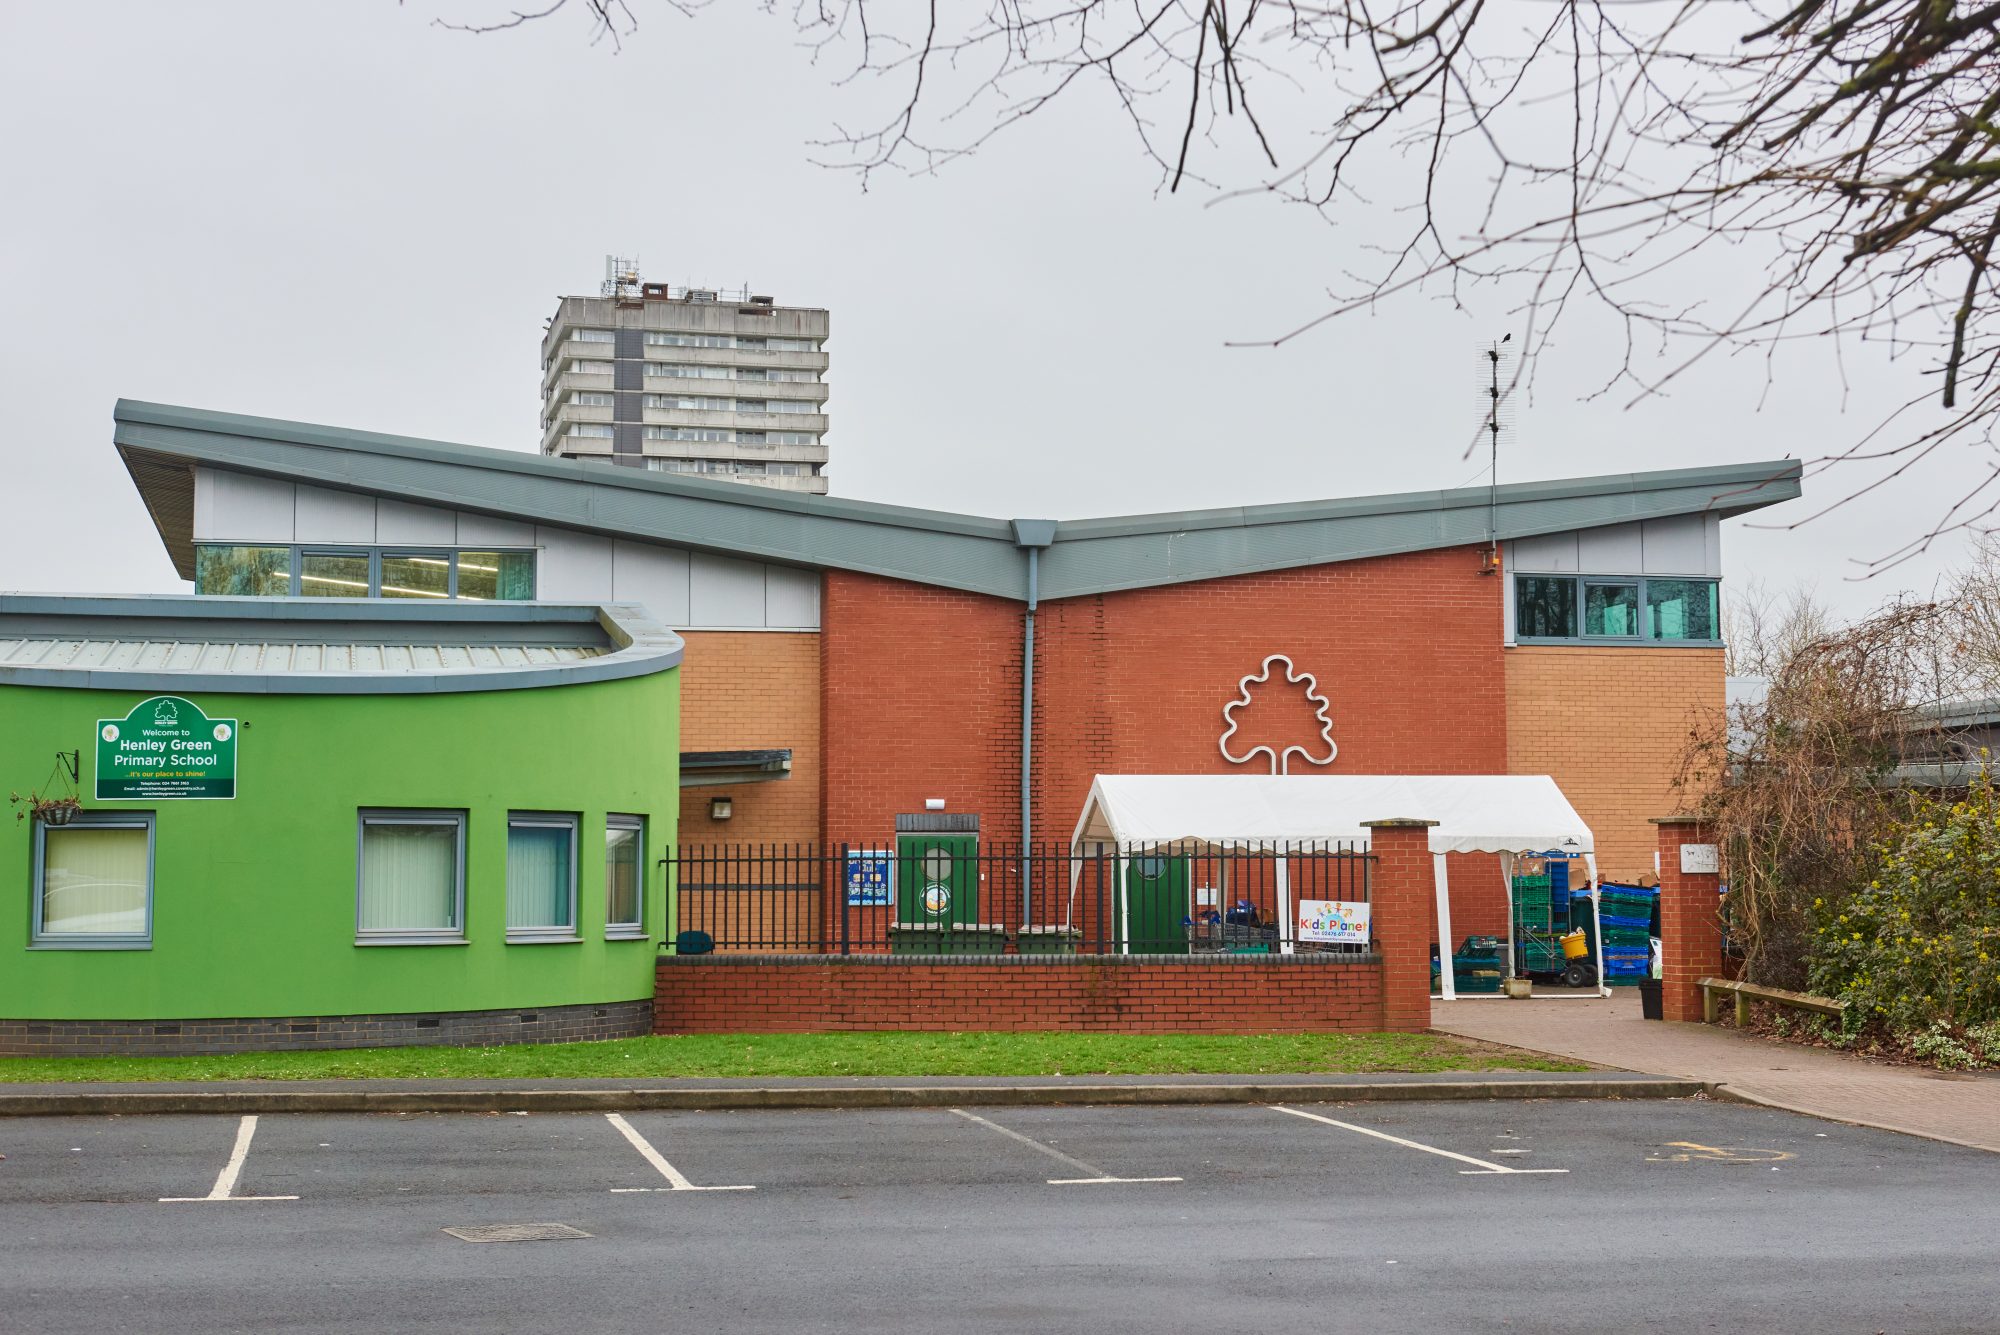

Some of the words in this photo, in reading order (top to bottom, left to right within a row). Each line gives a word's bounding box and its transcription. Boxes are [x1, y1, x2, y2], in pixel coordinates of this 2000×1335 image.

[120, 739, 166, 752] Henley
[170, 739, 212, 751] Green
[114, 754, 166, 768] Primary
[170, 754, 217, 766] School
[1300, 918, 1325, 929] Kids
[1329, 919, 1367, 931] Planet
